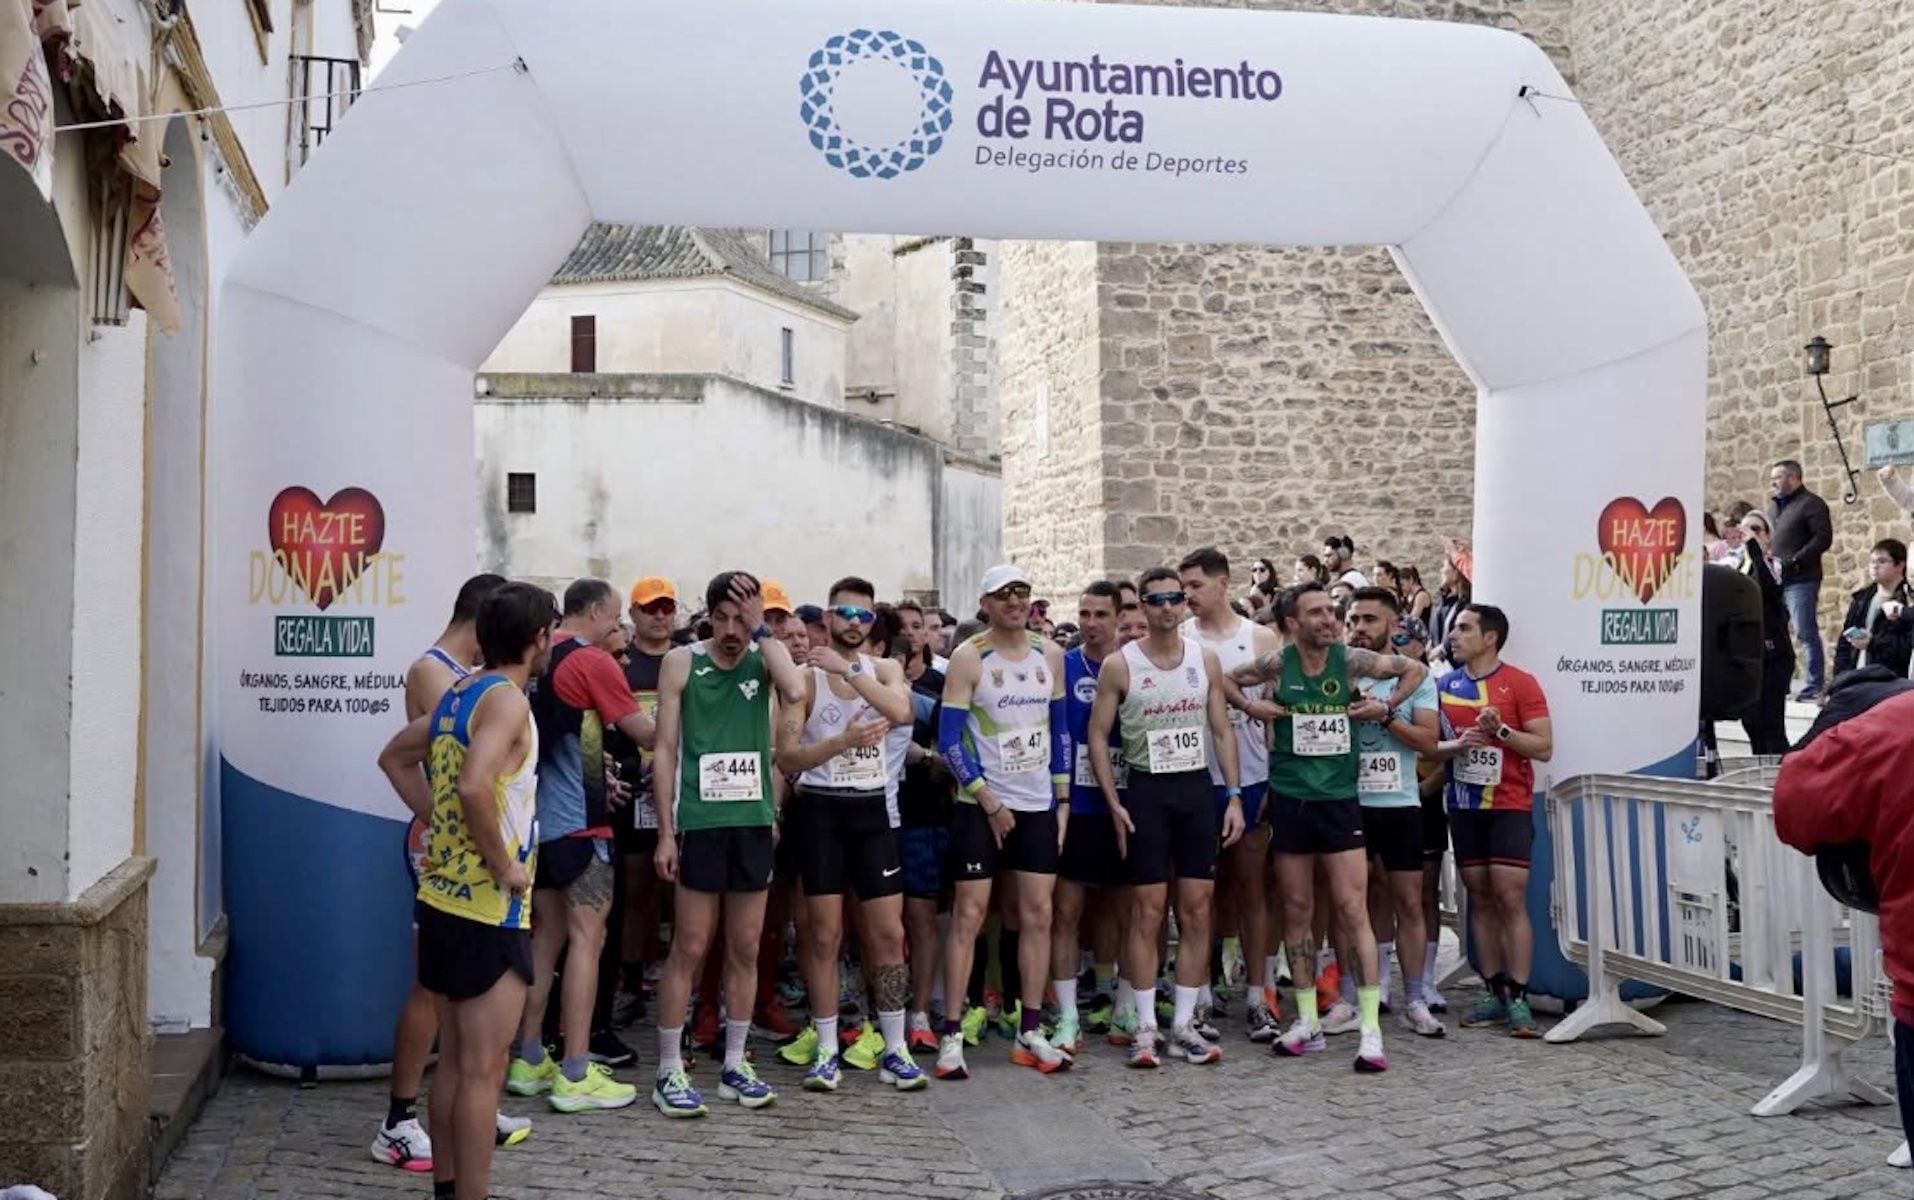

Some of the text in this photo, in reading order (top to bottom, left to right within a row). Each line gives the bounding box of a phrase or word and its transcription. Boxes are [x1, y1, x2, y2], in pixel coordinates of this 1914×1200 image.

[978, 50, 1282, 101] Ayuntamiento
[977, 95, 1144, 143] de Rota
[975, 146, 1248, 177] Delegación de Deportes
[282, 511, 366, 544] HAZTE
[1612, 518, 1677, 547] HAZTE
[248, 548, 407, 606] DONANTE
[1572, 550, 1695, 602] DONANTE
[278, 618, 371, 654] REGALA VIDA
[1604, 611, 1677, 641] REGALA VIDA
[1557, 655, 1616, 674] ÓRGANOS,
[1618, 659, 1663, 673] SANGRE,
[240, 668, 407, 692] ÓRGANOS, SANGRE, MÉDULA
[1582, 680, 1628, 694] TEJIDOS
[1630, 680, 1655, 693] PARA
[259, 696, 390, 715] TEJIDOS PARA TOD@S
[1318, 718, 1346, 735] 443
[1028, 731, 1042, 749] 47
[1174, 732, 1199, 749] 105
[855, 744, 880, 760] 405
[1470, 749, 1497, 767] 355
[727, 757, 756, 777] 444
[1369, 757, 1396, 773] 490
